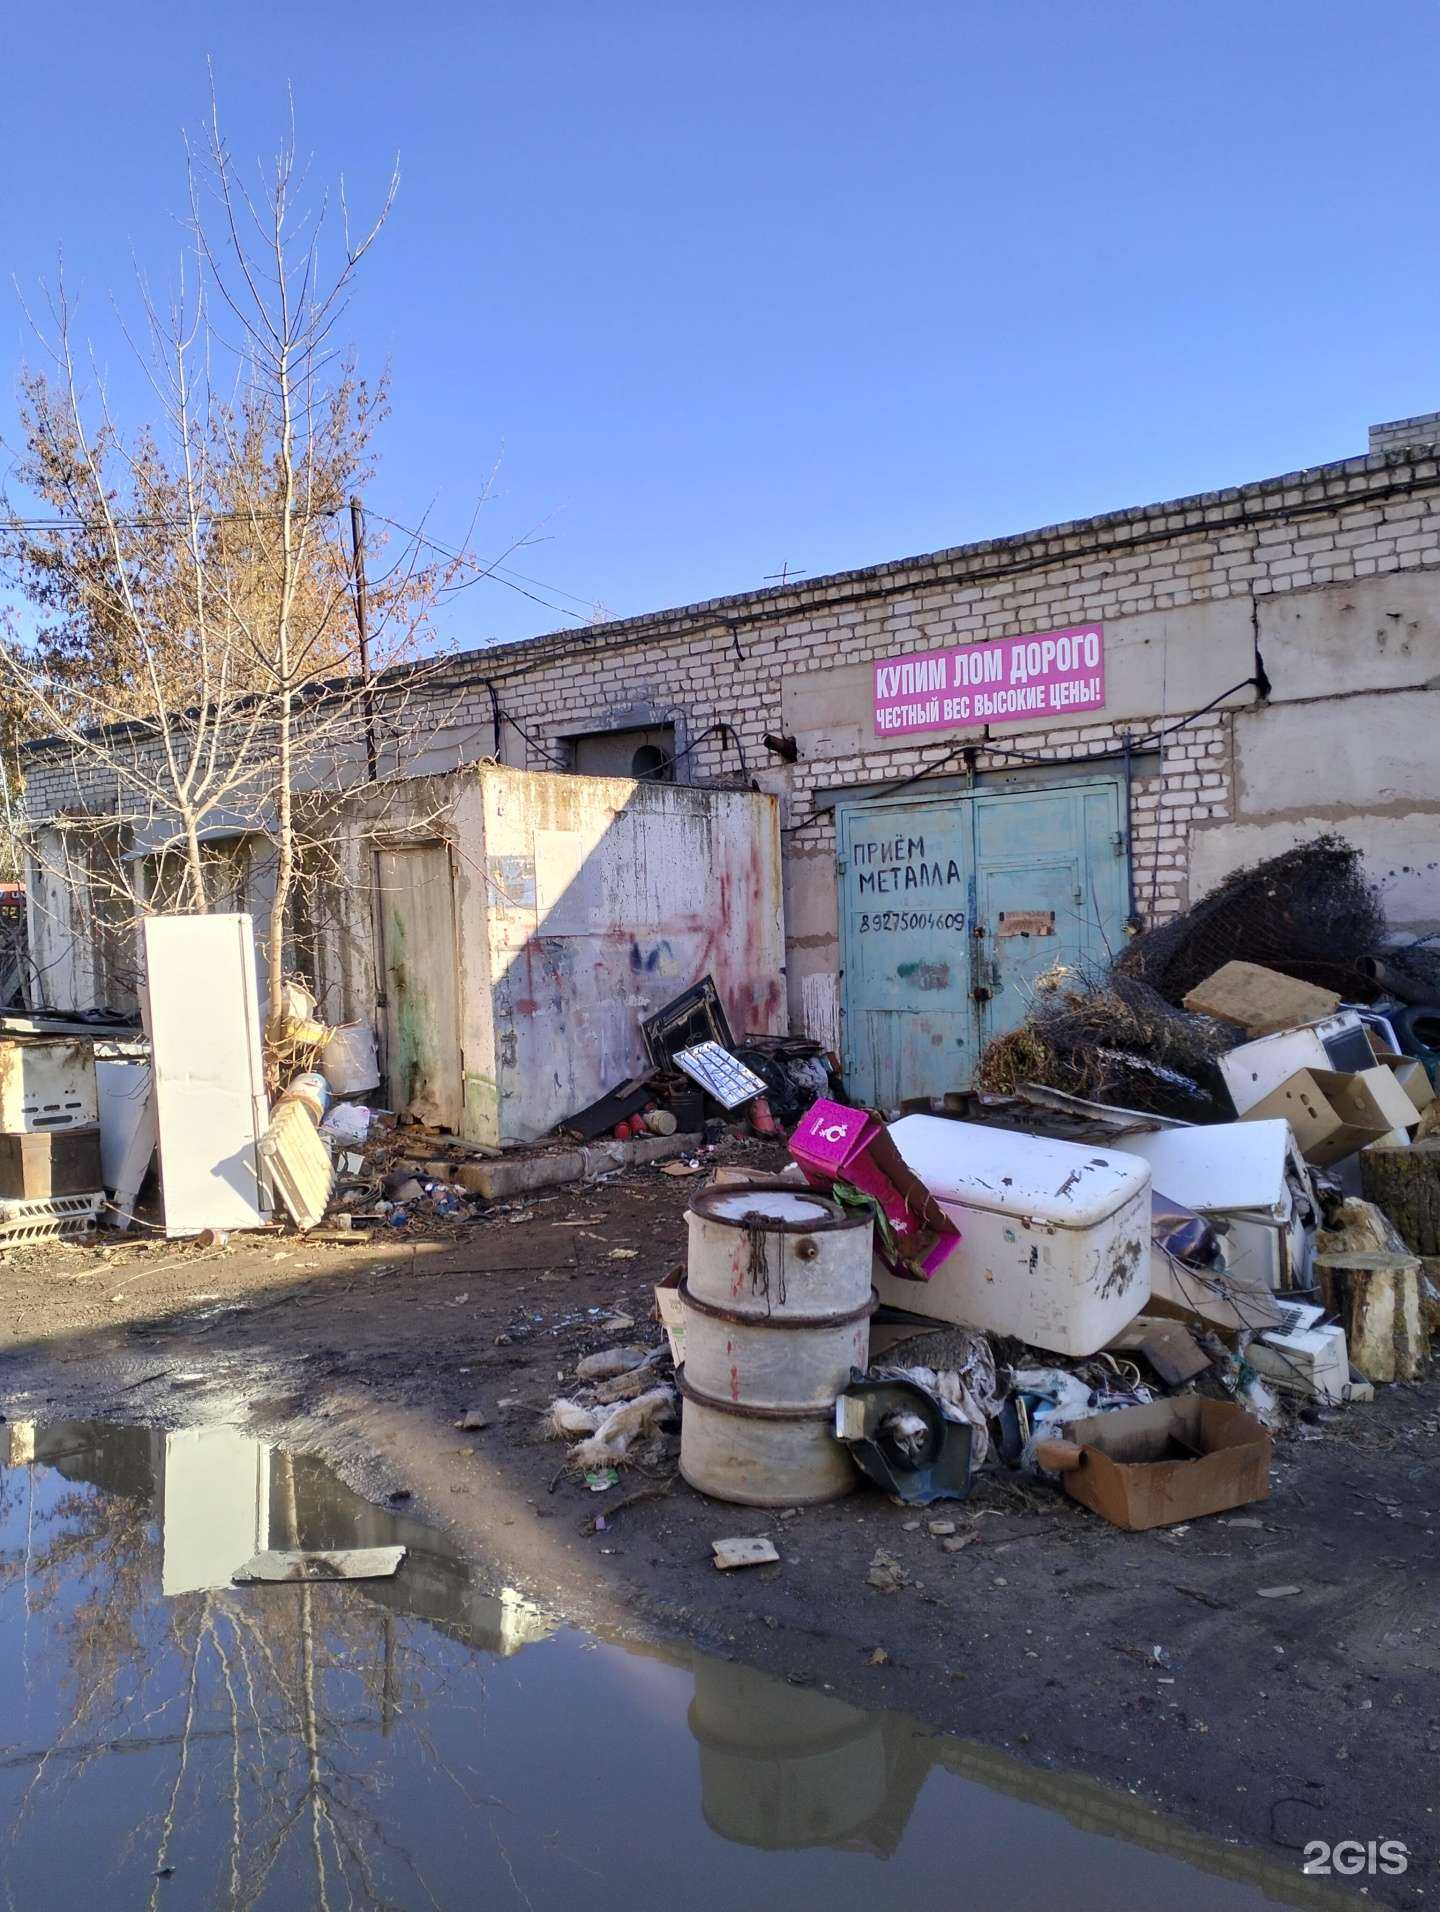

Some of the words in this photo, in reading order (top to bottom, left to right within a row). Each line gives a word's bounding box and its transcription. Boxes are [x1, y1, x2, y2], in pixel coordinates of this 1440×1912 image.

[876, 658, 946, 699] КУПИМ
[953, 649, 1002, 687] ЛОМ
[1010, 633, 1100, 685] ДОРОГО
[876, 697, 940, 729] ЧЕСТНЫЙ
[943, 697, 970, 720] ВЕС
[974, 686, 1045, 716] ВЫСОКИЕ
[1050, 678, 1101, 710] ЦЕНЫ!
[854, 834, 925, 865] ПРИЁМ
[859, 860, 960, 894] МЕТАЛЛА
